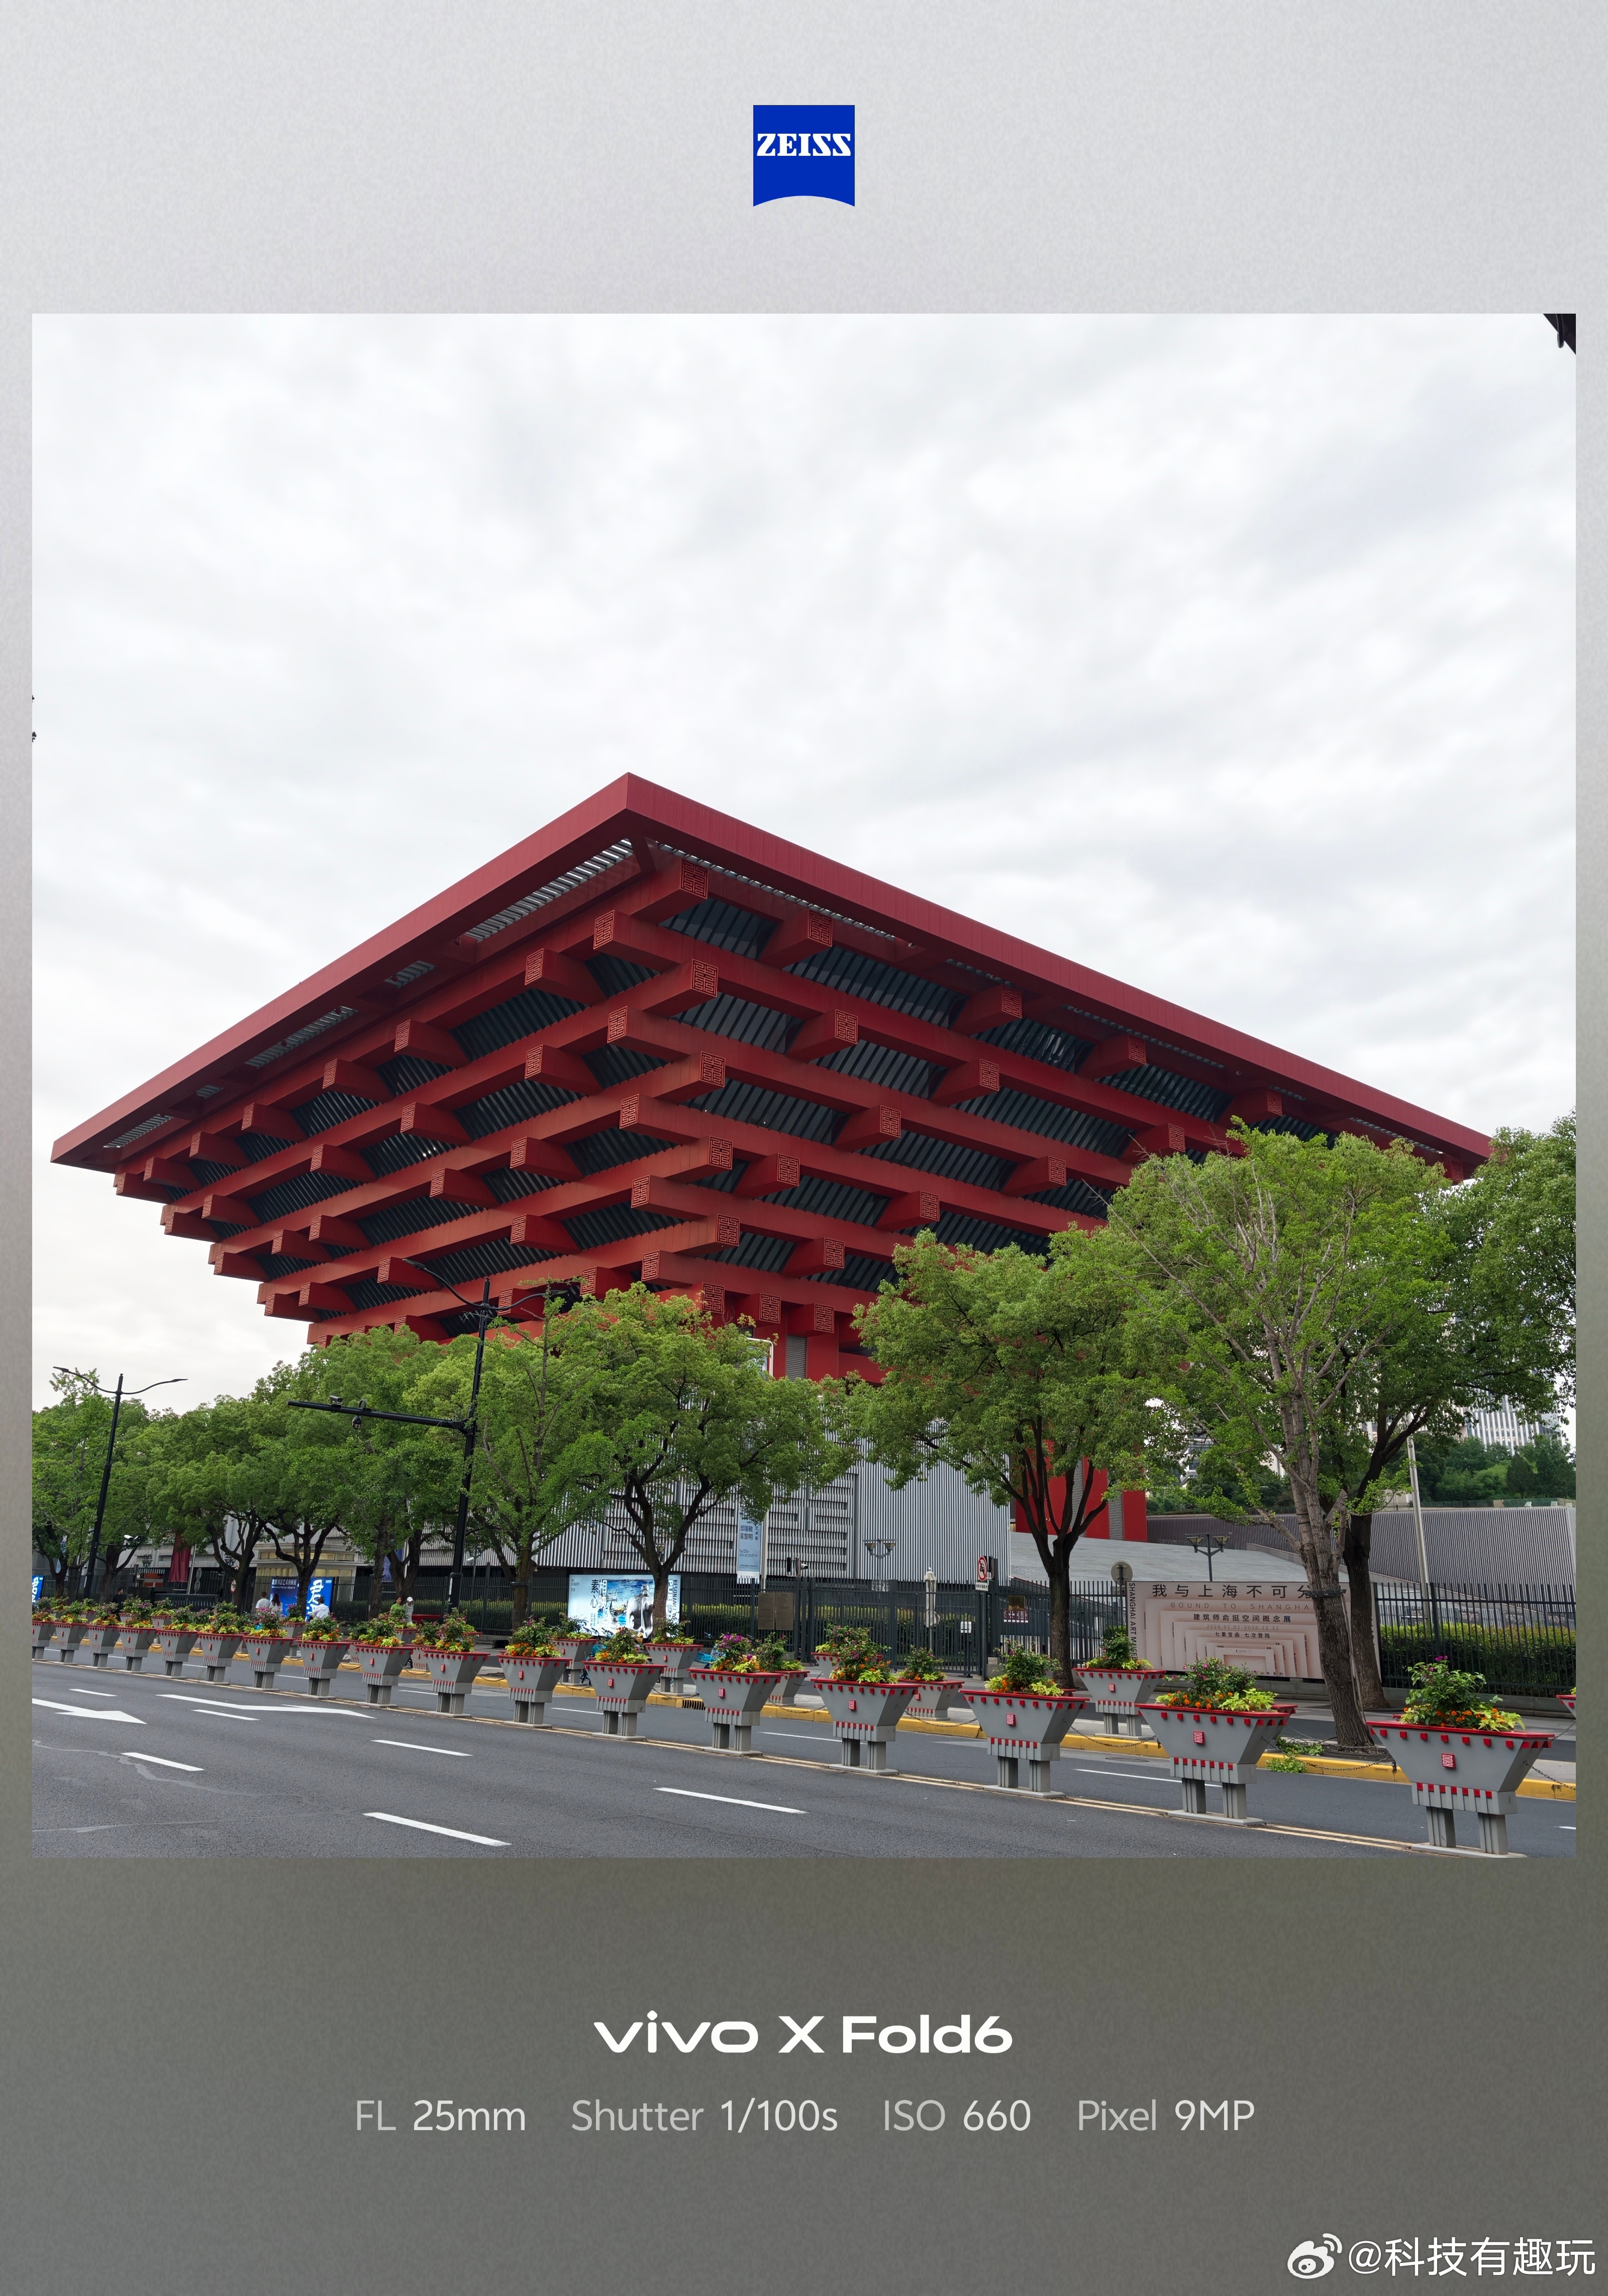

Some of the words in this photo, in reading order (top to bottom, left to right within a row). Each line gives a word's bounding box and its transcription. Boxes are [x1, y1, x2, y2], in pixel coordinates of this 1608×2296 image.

[590, 1579, 599, 1608] 素心
[1152, 1584, 1312, 1599] 我与上海不可分
